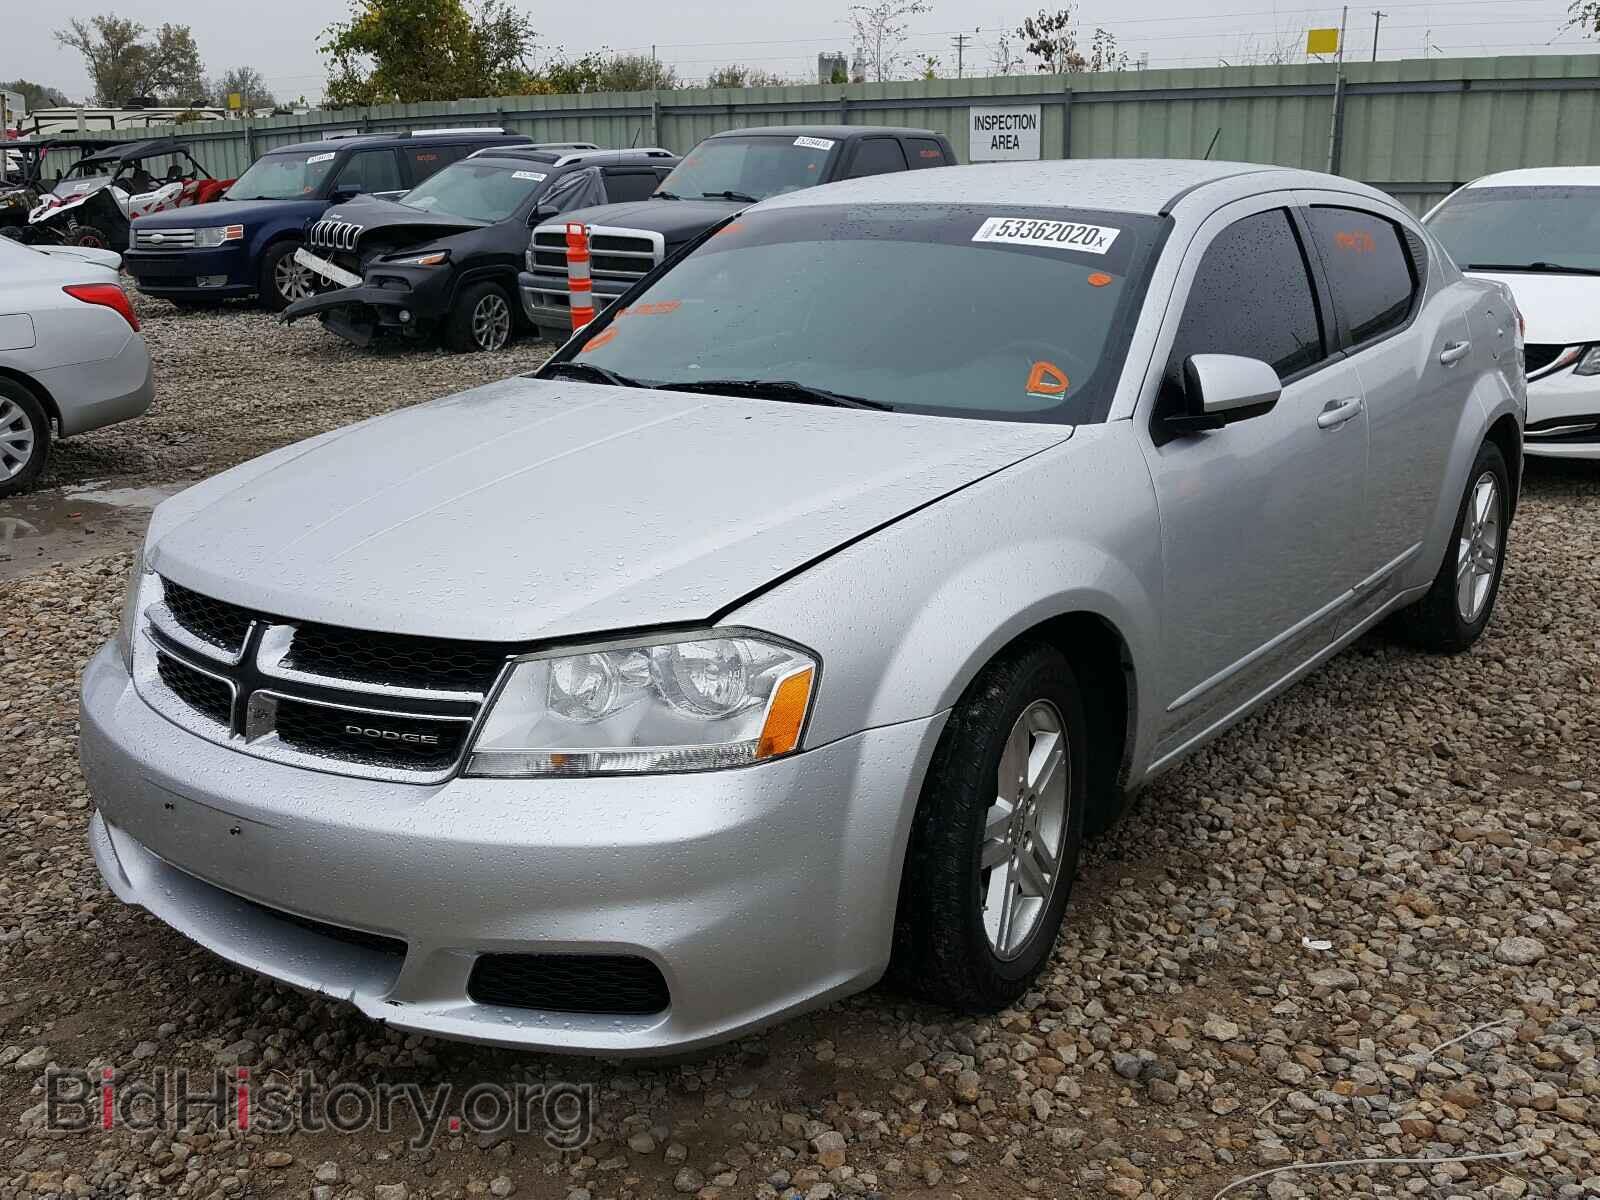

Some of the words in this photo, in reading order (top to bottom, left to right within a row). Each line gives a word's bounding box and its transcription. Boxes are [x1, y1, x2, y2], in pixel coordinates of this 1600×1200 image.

[974, 113, 1037, 131] INSPECTION
[990, 134, 1020, 150] AREA
[345, 725, 439, 744] DODGE
